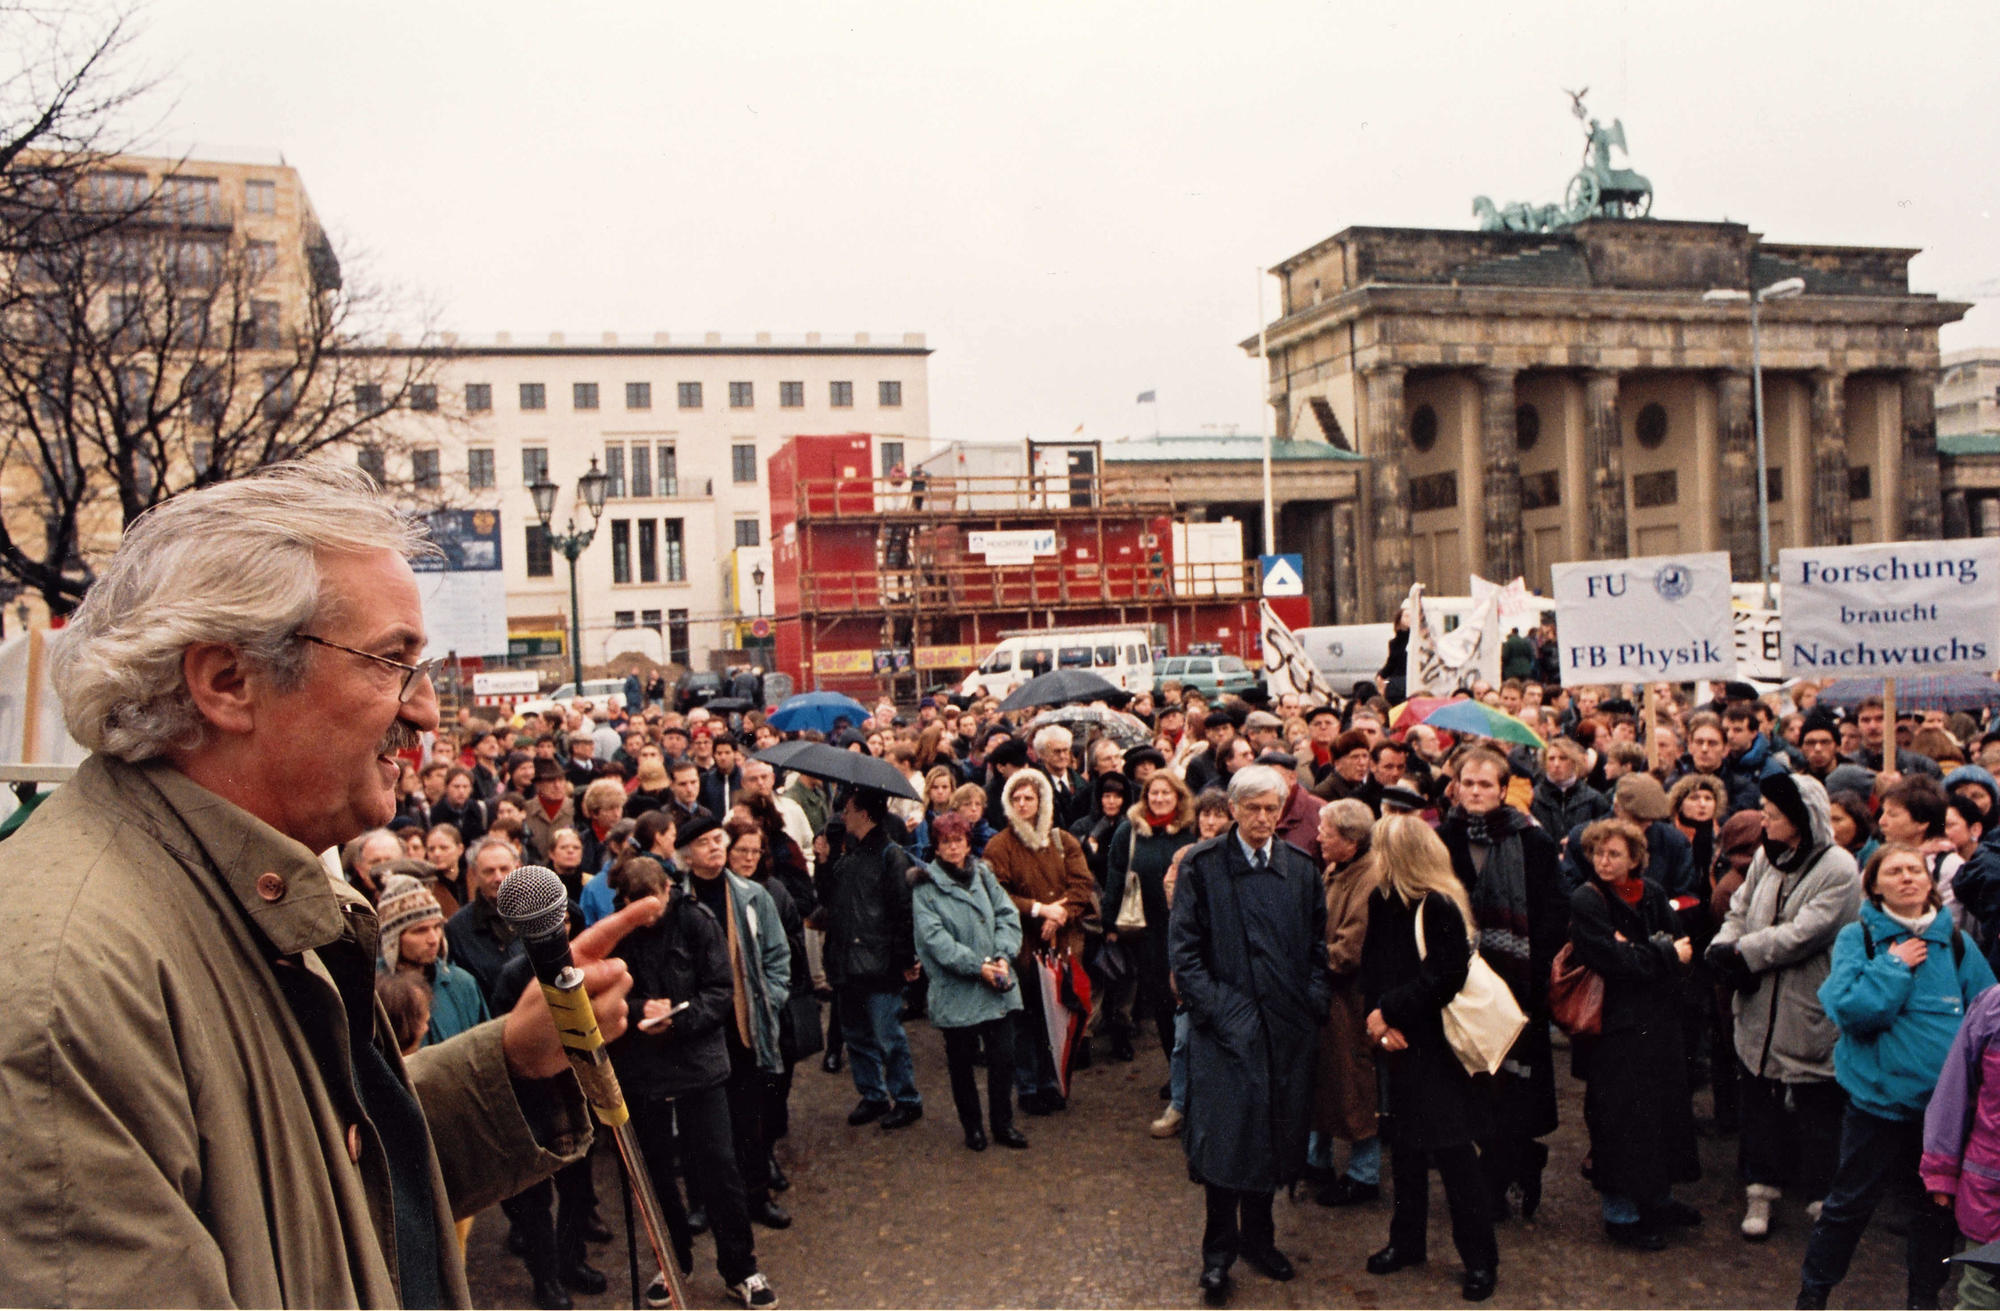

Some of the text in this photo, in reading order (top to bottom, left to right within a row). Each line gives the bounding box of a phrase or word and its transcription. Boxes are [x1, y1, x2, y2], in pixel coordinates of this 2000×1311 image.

[1801, 556, 1979, 585] Forschung
[1586, 574, 1628, 598] FU
[1840, 603, 1938, 626] braucht
[1570, 646, 1607, 668] FB
[1617, 639, 1721, 673] Physik
[1793, 637, 1988, 667] Nachwuchs
